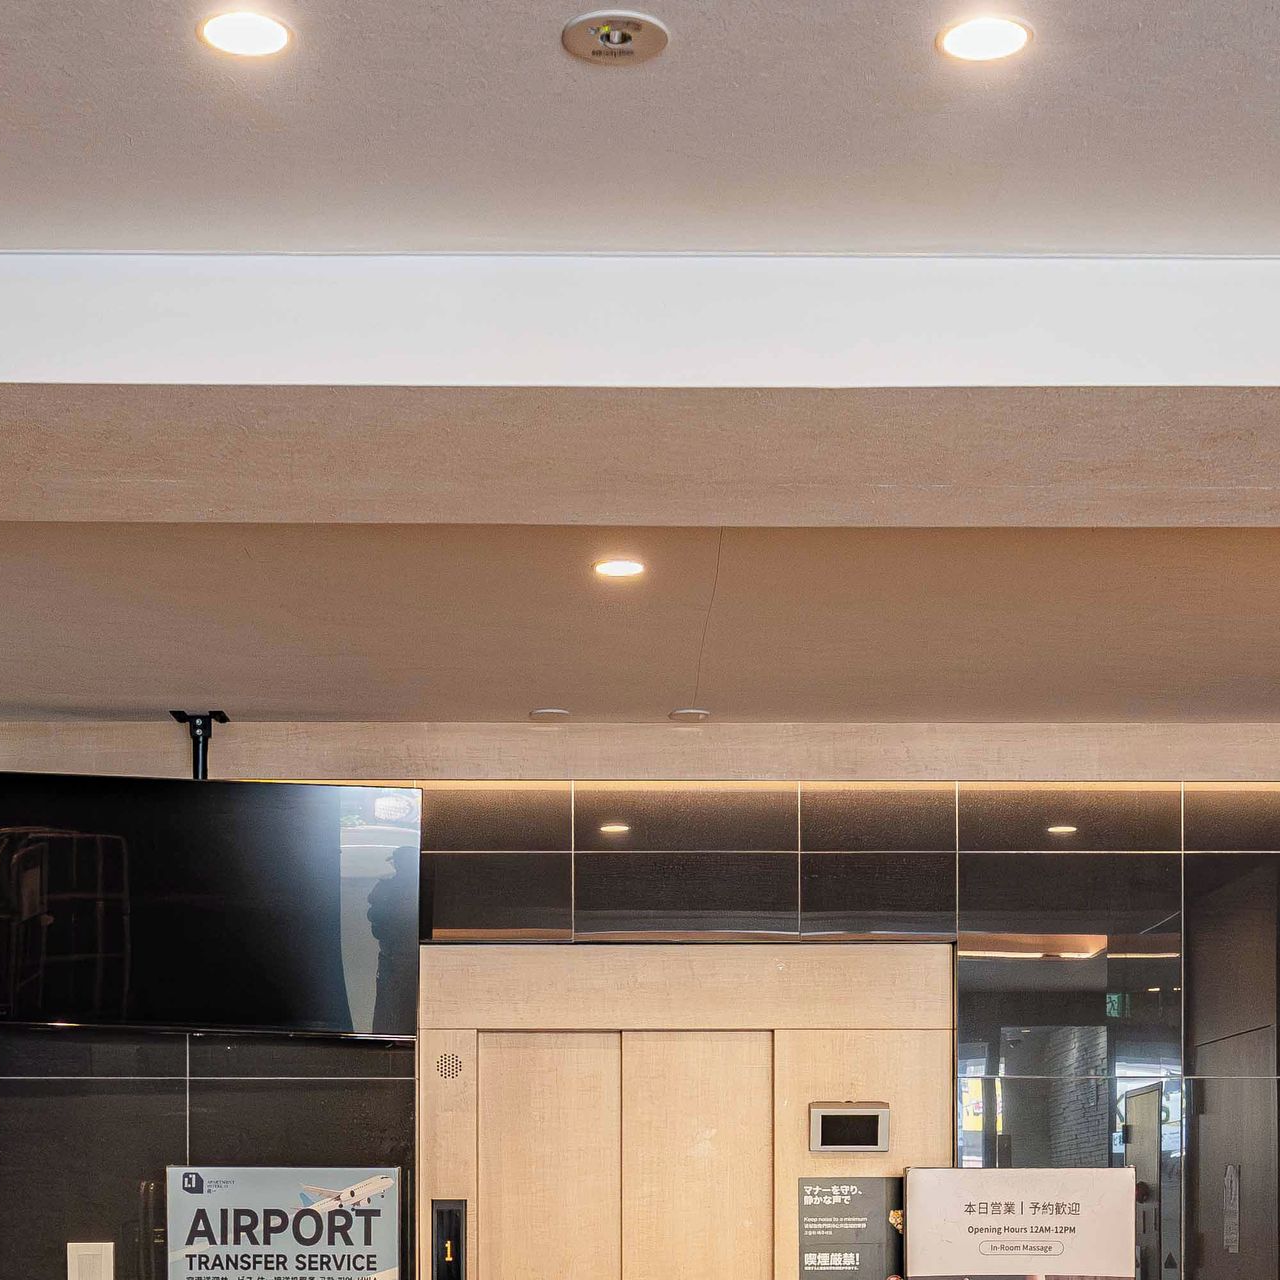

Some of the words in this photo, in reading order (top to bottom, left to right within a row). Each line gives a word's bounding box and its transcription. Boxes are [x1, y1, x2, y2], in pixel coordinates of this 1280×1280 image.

[803, 1185, 863, 1195] マナーを守り、
[803, 1195, 851, 1205] 静かな声で
[964, 1201, 1016, 1216] 本日営業
[185, 1208, 381, 1246] AIRPORT
[967, 1225, 1002, 1235] Opening
[1003, 1225, 1028, 1234] Hours
[1029, 1225, 1076, 1234] 12AM-12PM
[445, 1240, 453, 1261] 1
[990, 1244, 1021, 1252] In-Room
[1022, 1244, 1053, 1253] Massage
[185, 1254, 288, 1271] TRANSFER
[295, 1254, 378, 1271] SERVICE
[804, 1252, 859, 1265] 喫煙厳禁!
